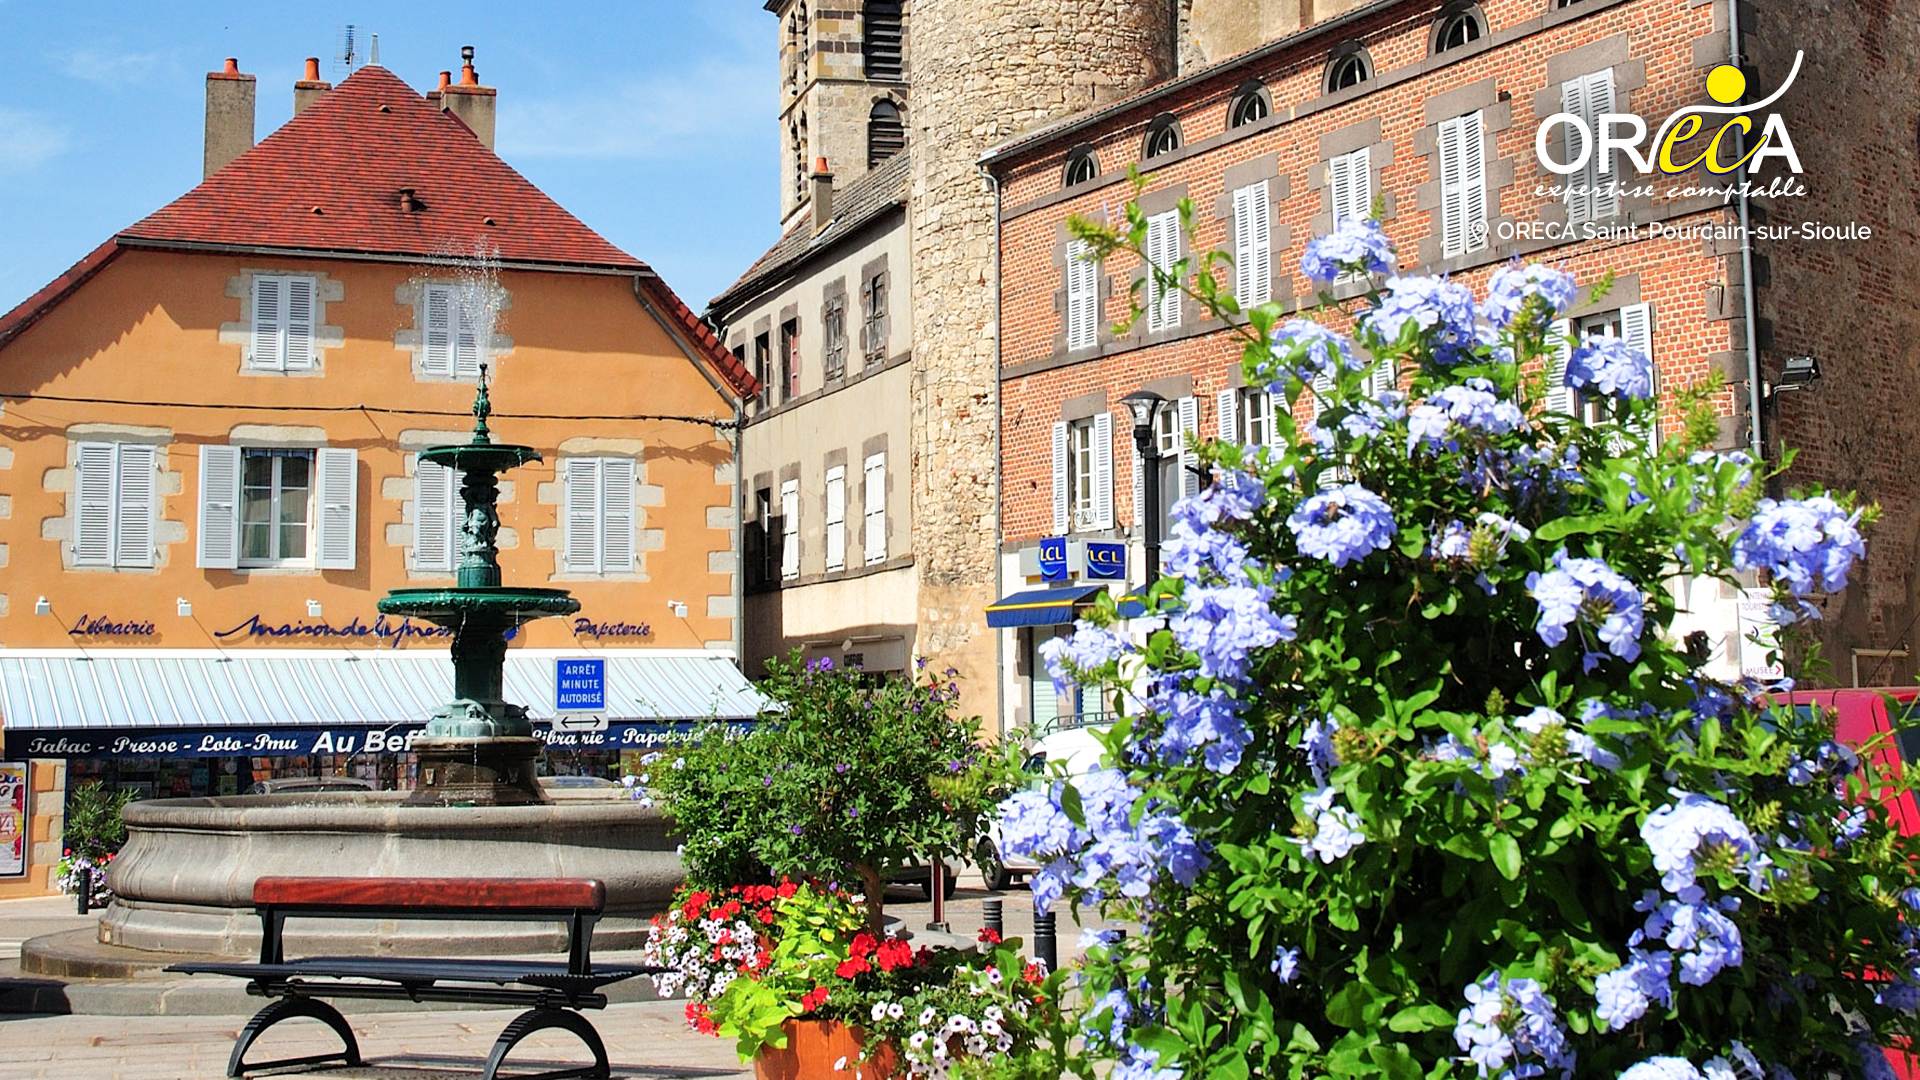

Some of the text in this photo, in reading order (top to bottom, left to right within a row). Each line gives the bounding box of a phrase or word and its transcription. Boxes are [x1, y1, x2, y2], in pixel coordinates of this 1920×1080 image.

[1040, 546, 1063, 562] LCL
[1089, 549, 1121, 563] LCL
[68, 613, 155, 635] Librairie
[573, 617, 650, 640] Papeterie
[565, 663, 596, 676] ARRÊT
[562, 679, 600, 690] MINUTE
[560, 691, 603, 704] AUTORISÉ
[28, 737, 92, 754] Tabac
[111, 736, 178, 754] Presse
[310, 731, 355, 754] Au
